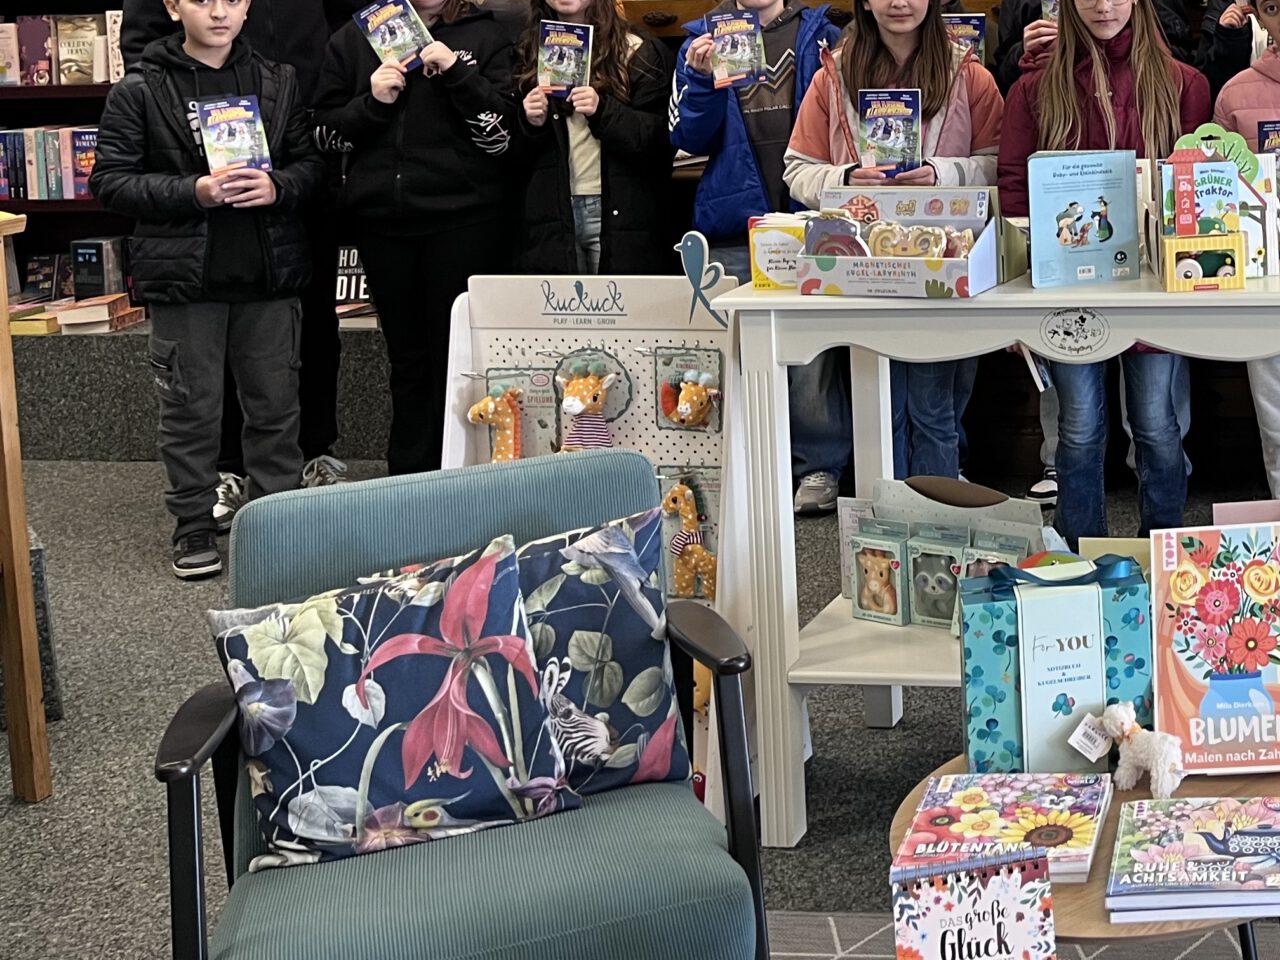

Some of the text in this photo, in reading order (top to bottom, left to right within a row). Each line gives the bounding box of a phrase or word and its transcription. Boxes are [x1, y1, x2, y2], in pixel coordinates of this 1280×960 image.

[1194, 174, 1233, 188] GRÜNER
[1194, 185, 1234, 199] Traktor
[338, 248, 359, 267] HO
[335, 275, 370, 300] DIE
[540, 279, 625, 313] kuckuck
[1165, 531, 1176, 568] TOPP
[1032, 633, 1095, 662] For YOU
[1185, 749, 1223, 763] Malen
[1225, 748, 1256, 762] nach
[915, 841, 1032, 855] BLÜTENTANZ
[1133, 862, 1181, 873] RUHE
[1119, 870, 1249, 885] ACHTSAMKEIT
[939, 900, 1009, 929] DAS große
[939, 922, 1014, 960] Glück
